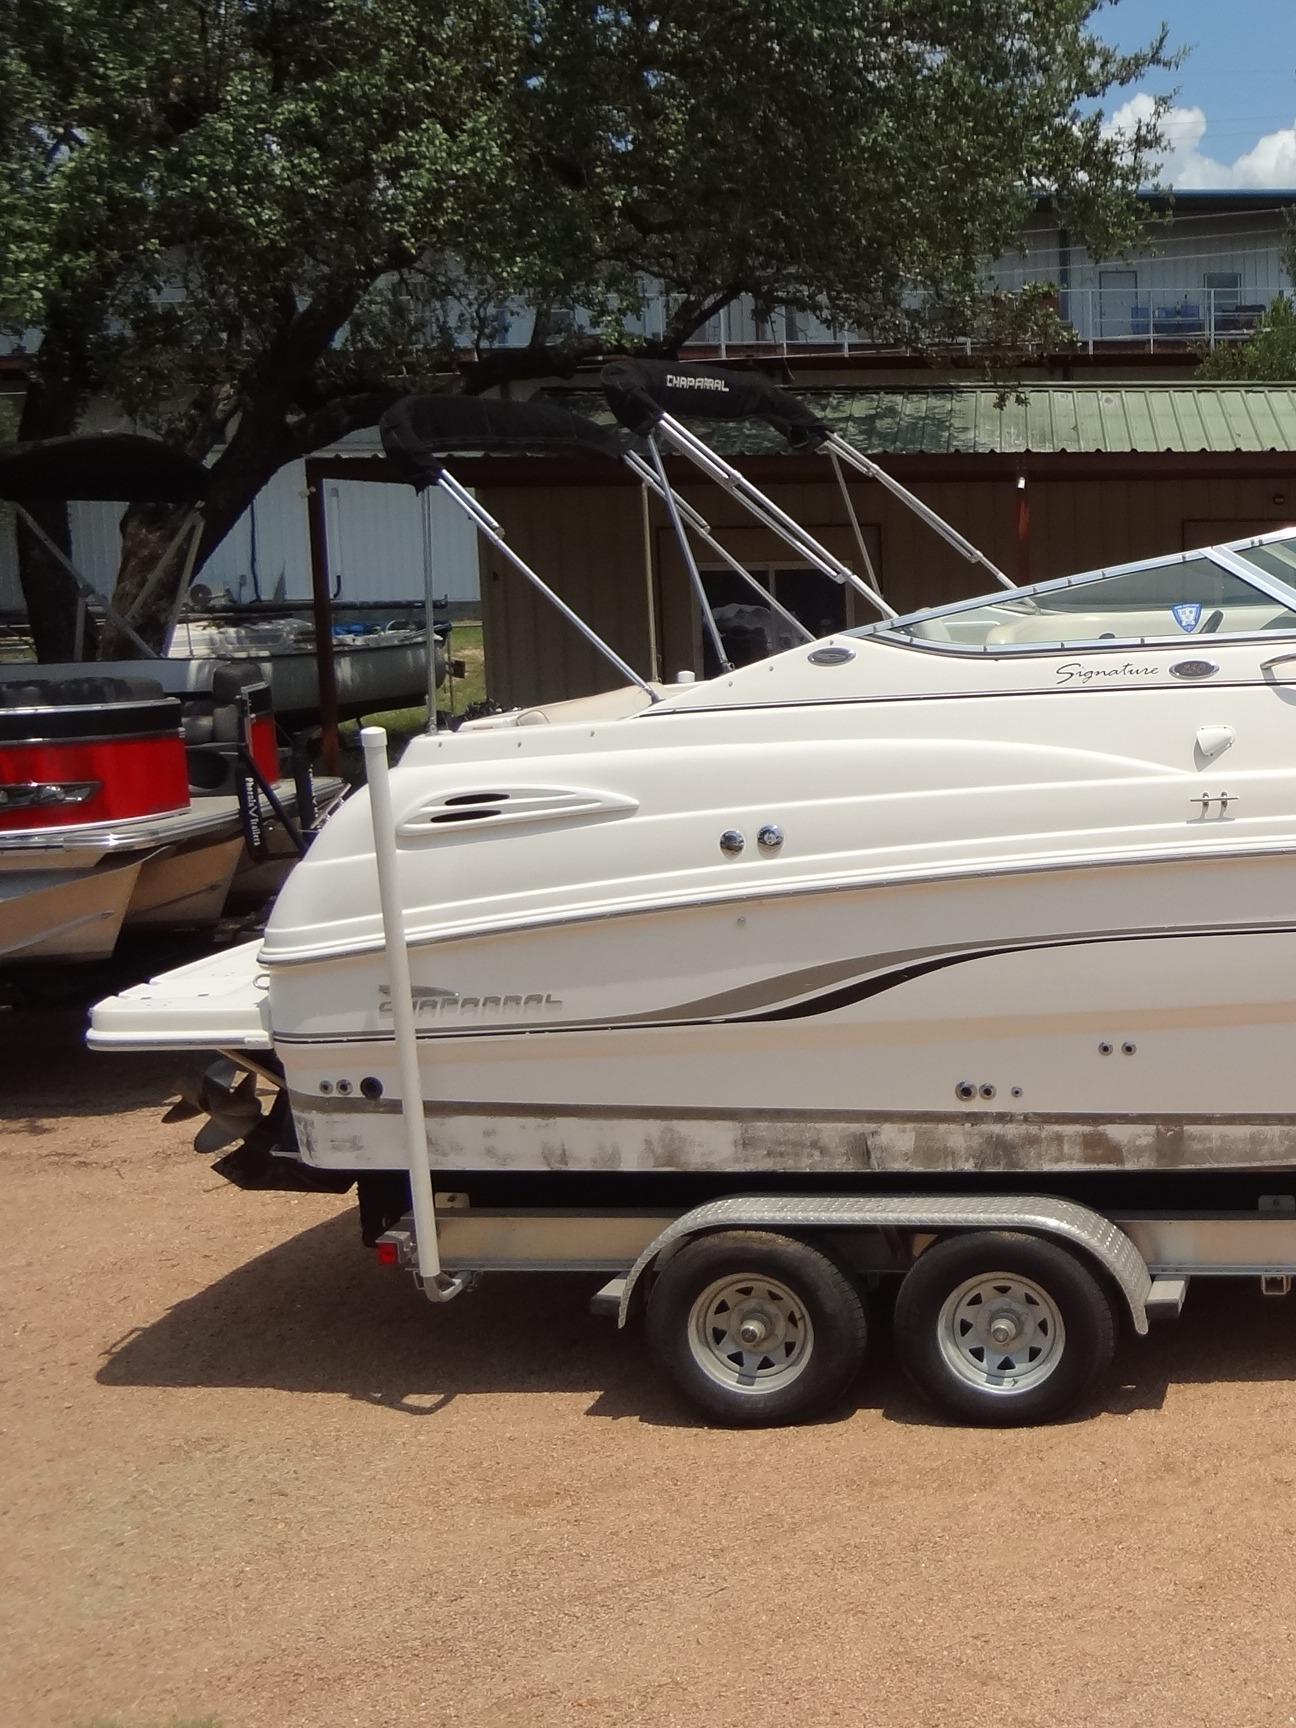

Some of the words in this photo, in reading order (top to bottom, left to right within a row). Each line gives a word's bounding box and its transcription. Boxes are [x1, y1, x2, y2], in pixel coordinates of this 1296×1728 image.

[666, 374, 730, 392] CHAPARRAL
[1056, 662, 1160, 685] Signature
[377, 994, 563, 1016] CAPARRAL
